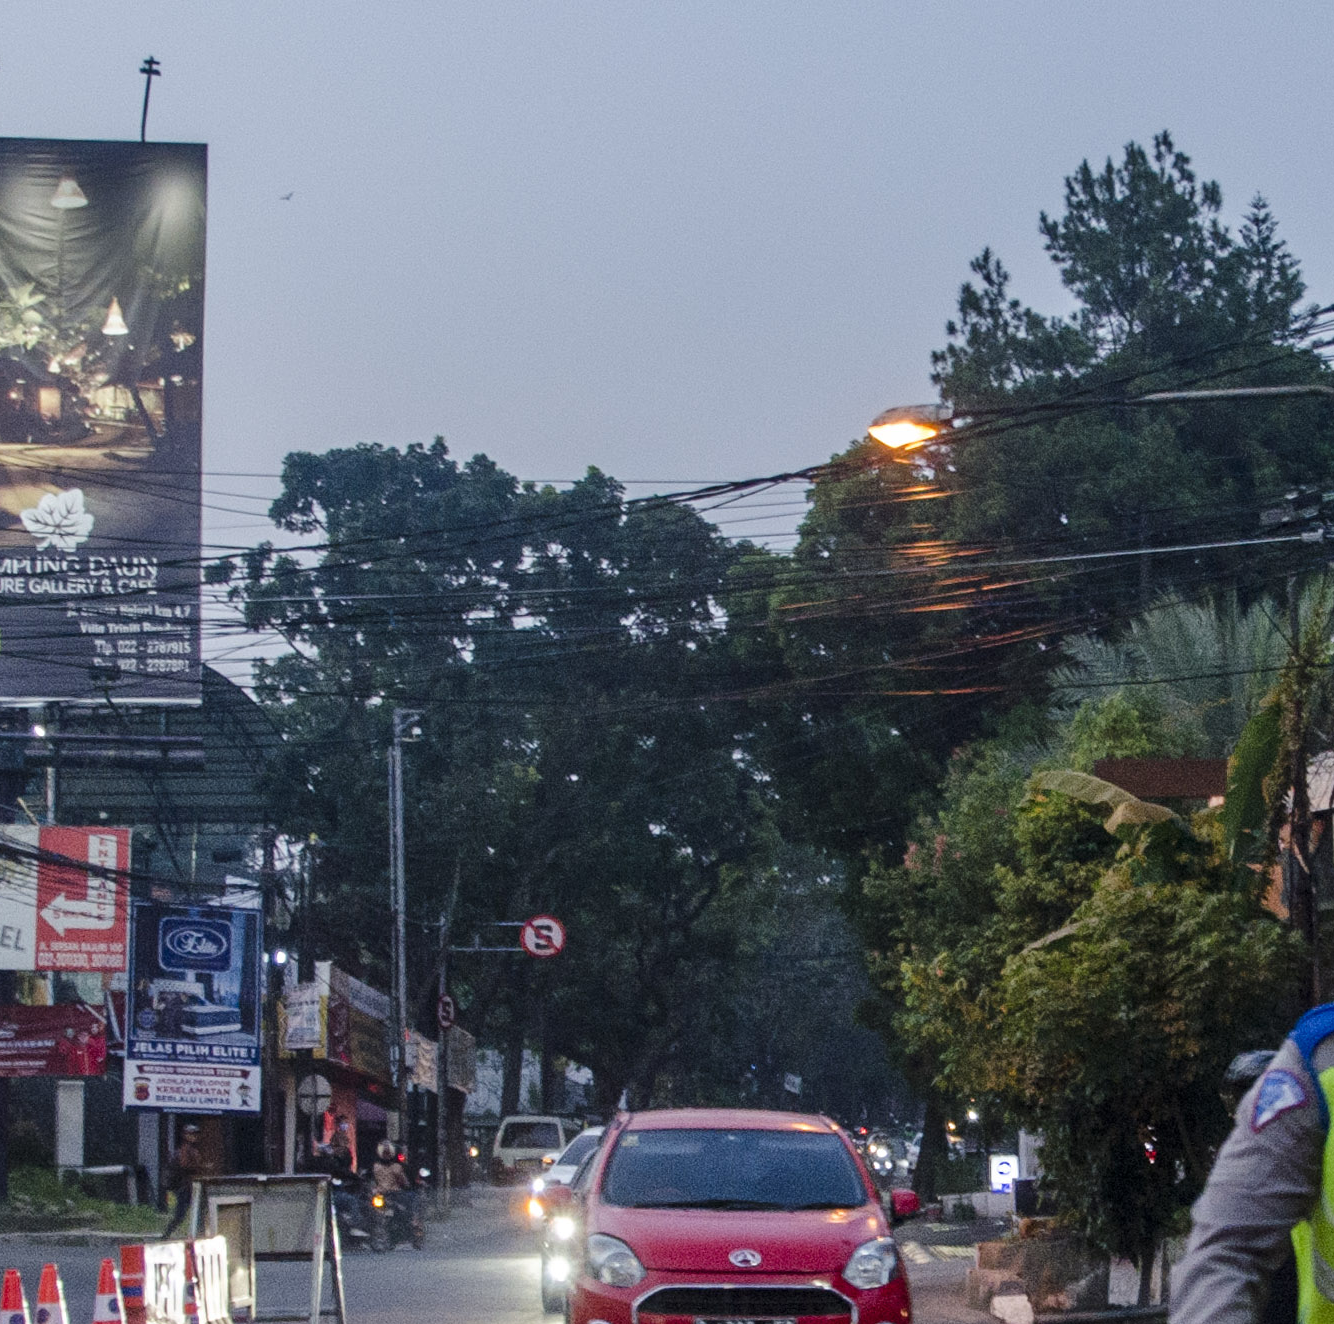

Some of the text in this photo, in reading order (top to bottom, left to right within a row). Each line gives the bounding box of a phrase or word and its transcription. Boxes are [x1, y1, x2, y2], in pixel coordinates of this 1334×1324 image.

[88, 555, 158, 578] DAUN
[28, 578, 95, 594] GALLERY
[101, 579, 114, 594] &
[132, 1042, 256, 1058] JELAS PILIH ELITE !
[156, 1085, 231, 1095] KESELAMATAN
[198, 1096, 231, 1105] LINTAS
